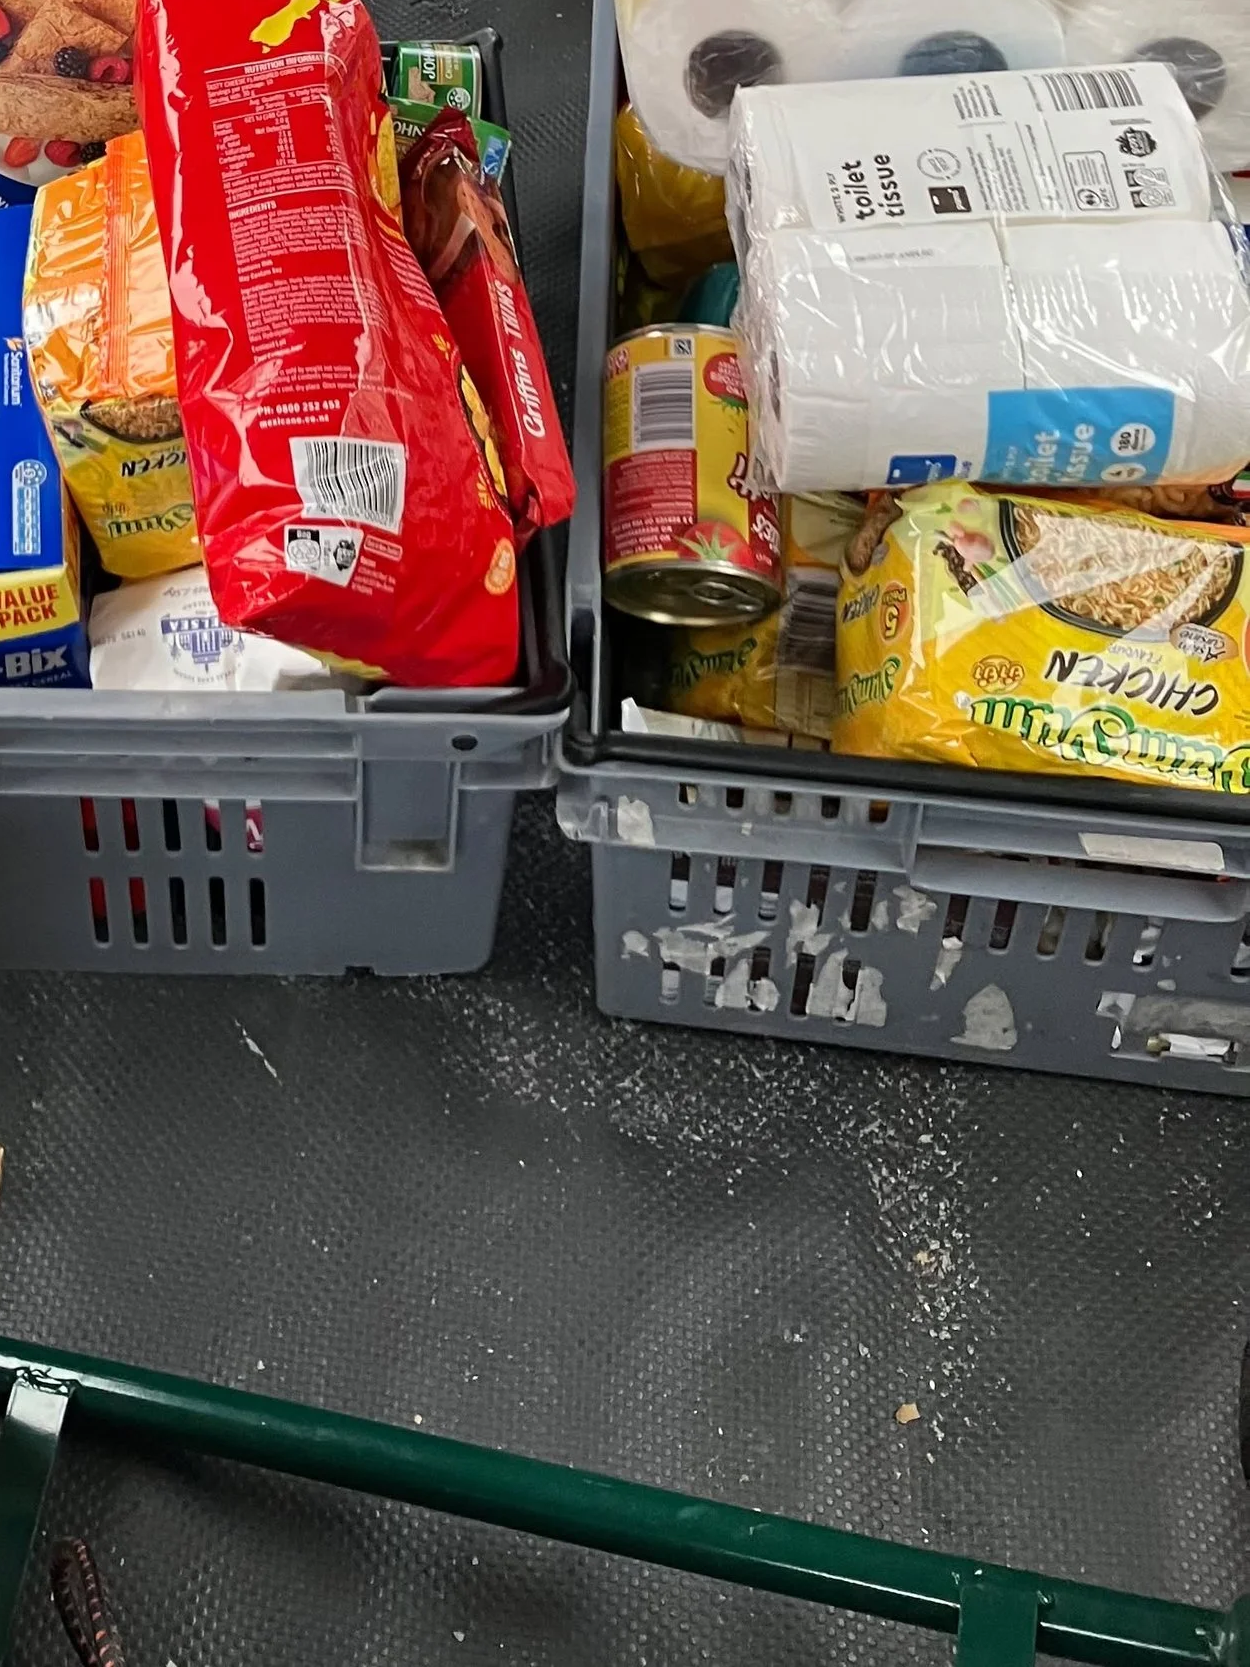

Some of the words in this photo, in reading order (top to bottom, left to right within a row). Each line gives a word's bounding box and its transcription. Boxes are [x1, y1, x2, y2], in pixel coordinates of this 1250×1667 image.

[244, 58, 284, 74] NUTRITION
[296, 64, 315, 74] CHIPS
[825, 172, 838, 186] PLY
[841, 159, 875, 221] toilet
[871, 153, 906, 218] tissue
[228, 200, 277, 220] INGREDIENTS
[494, 279, 522, 339] THINS
[9, 350, 23, 407] Sanitarium
[276, 402, 301, 414] 0800
[302, 401, 321, 412] 252
[322, 399, 340, 410] 452
[1053, 422, 1095, 484] tissue
[1117, 431, 1131, 451] 180
[120, 452, 187, 478] ICKEN
[1023, 430, 1060, 484] toilet
[884, 607, 899, 638] 5
[1044, 649, 1221, 715] CHICKEN
